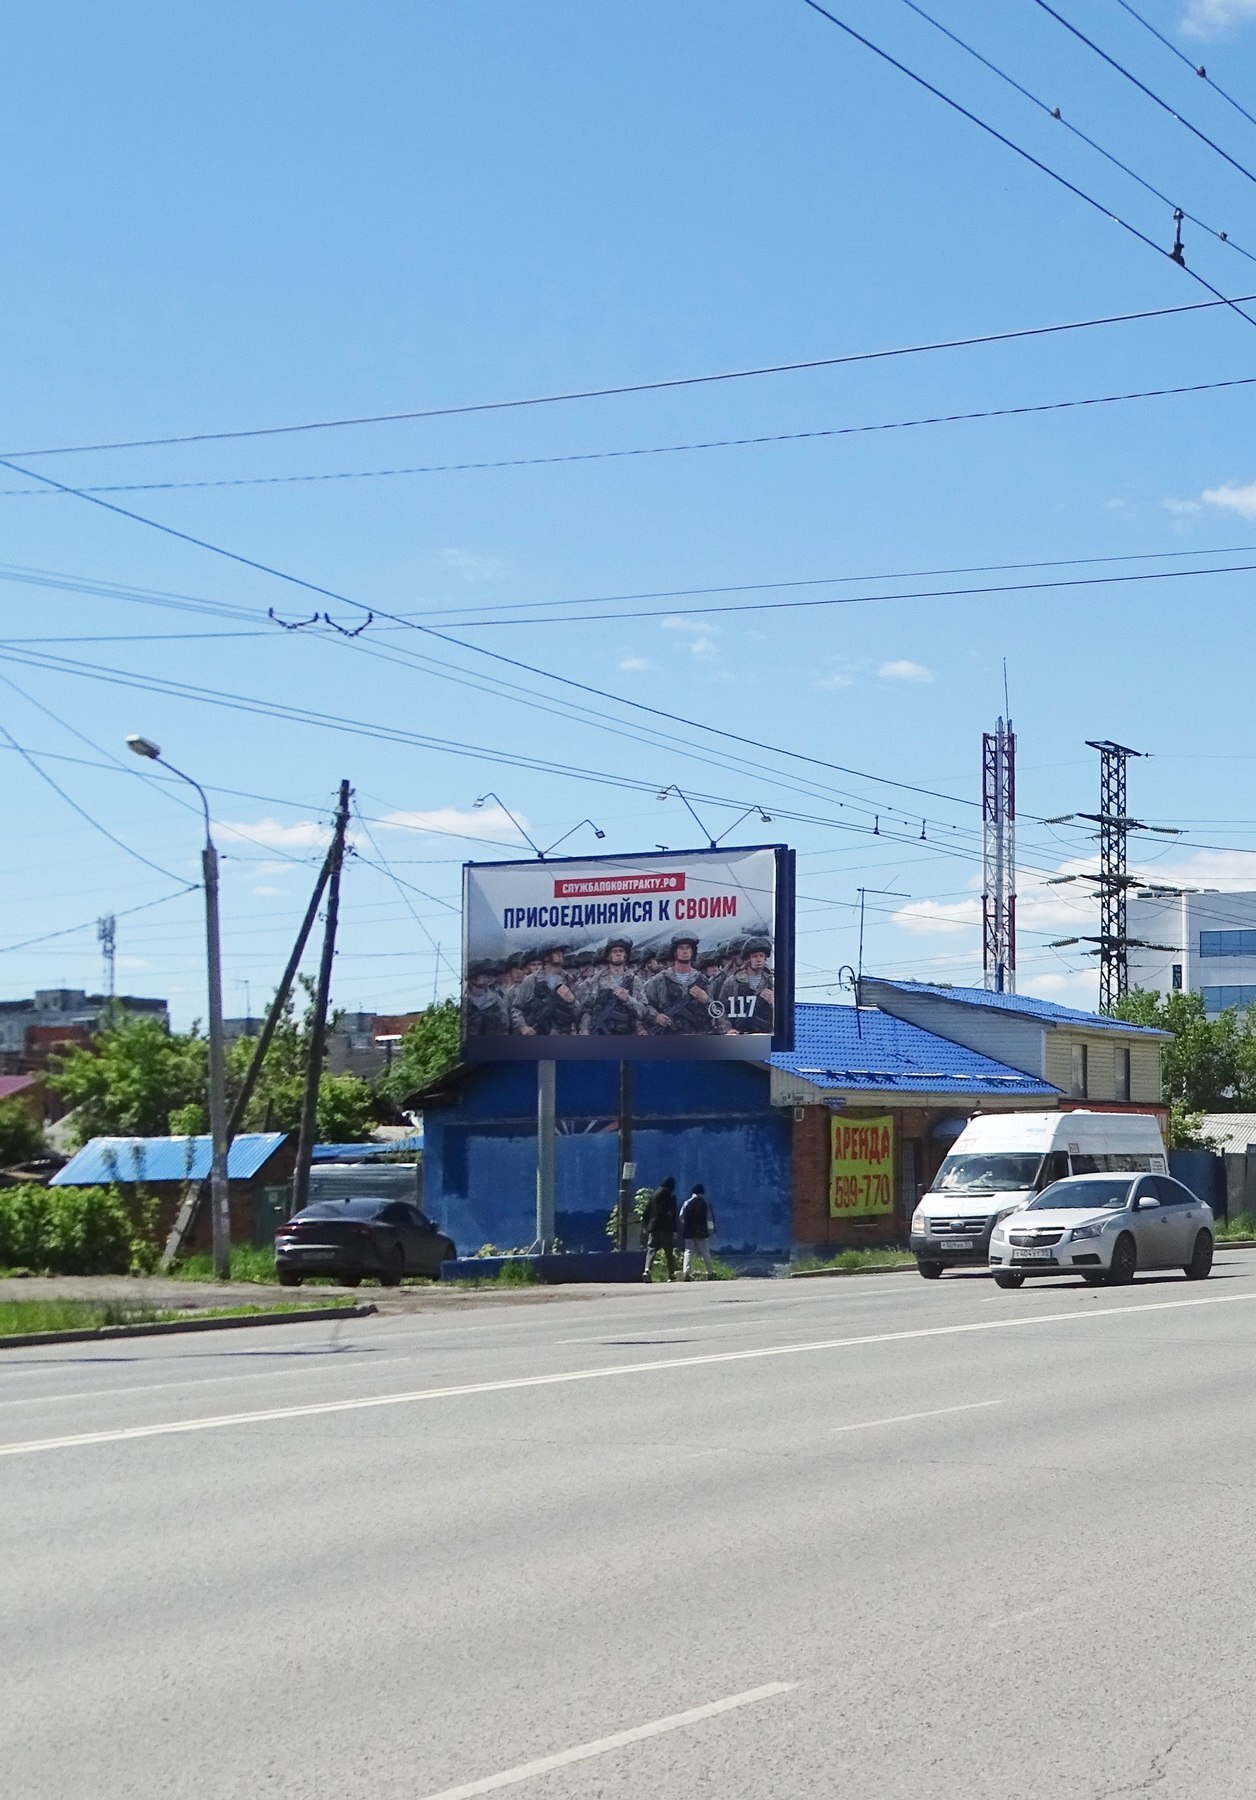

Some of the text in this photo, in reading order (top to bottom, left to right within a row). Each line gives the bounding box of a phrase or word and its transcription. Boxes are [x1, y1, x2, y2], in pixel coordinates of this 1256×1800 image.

[562, 877, 677, 893] СЛУЖБАПОКОНТРАКТУ.РФ
[503, 896, 737, 929] ПРИСОЕДИНЯЙСЯ К СВОИМ
[728, 995, 757, 1018] 117
[835, 1126, 891, 1165] АРЕНДА
